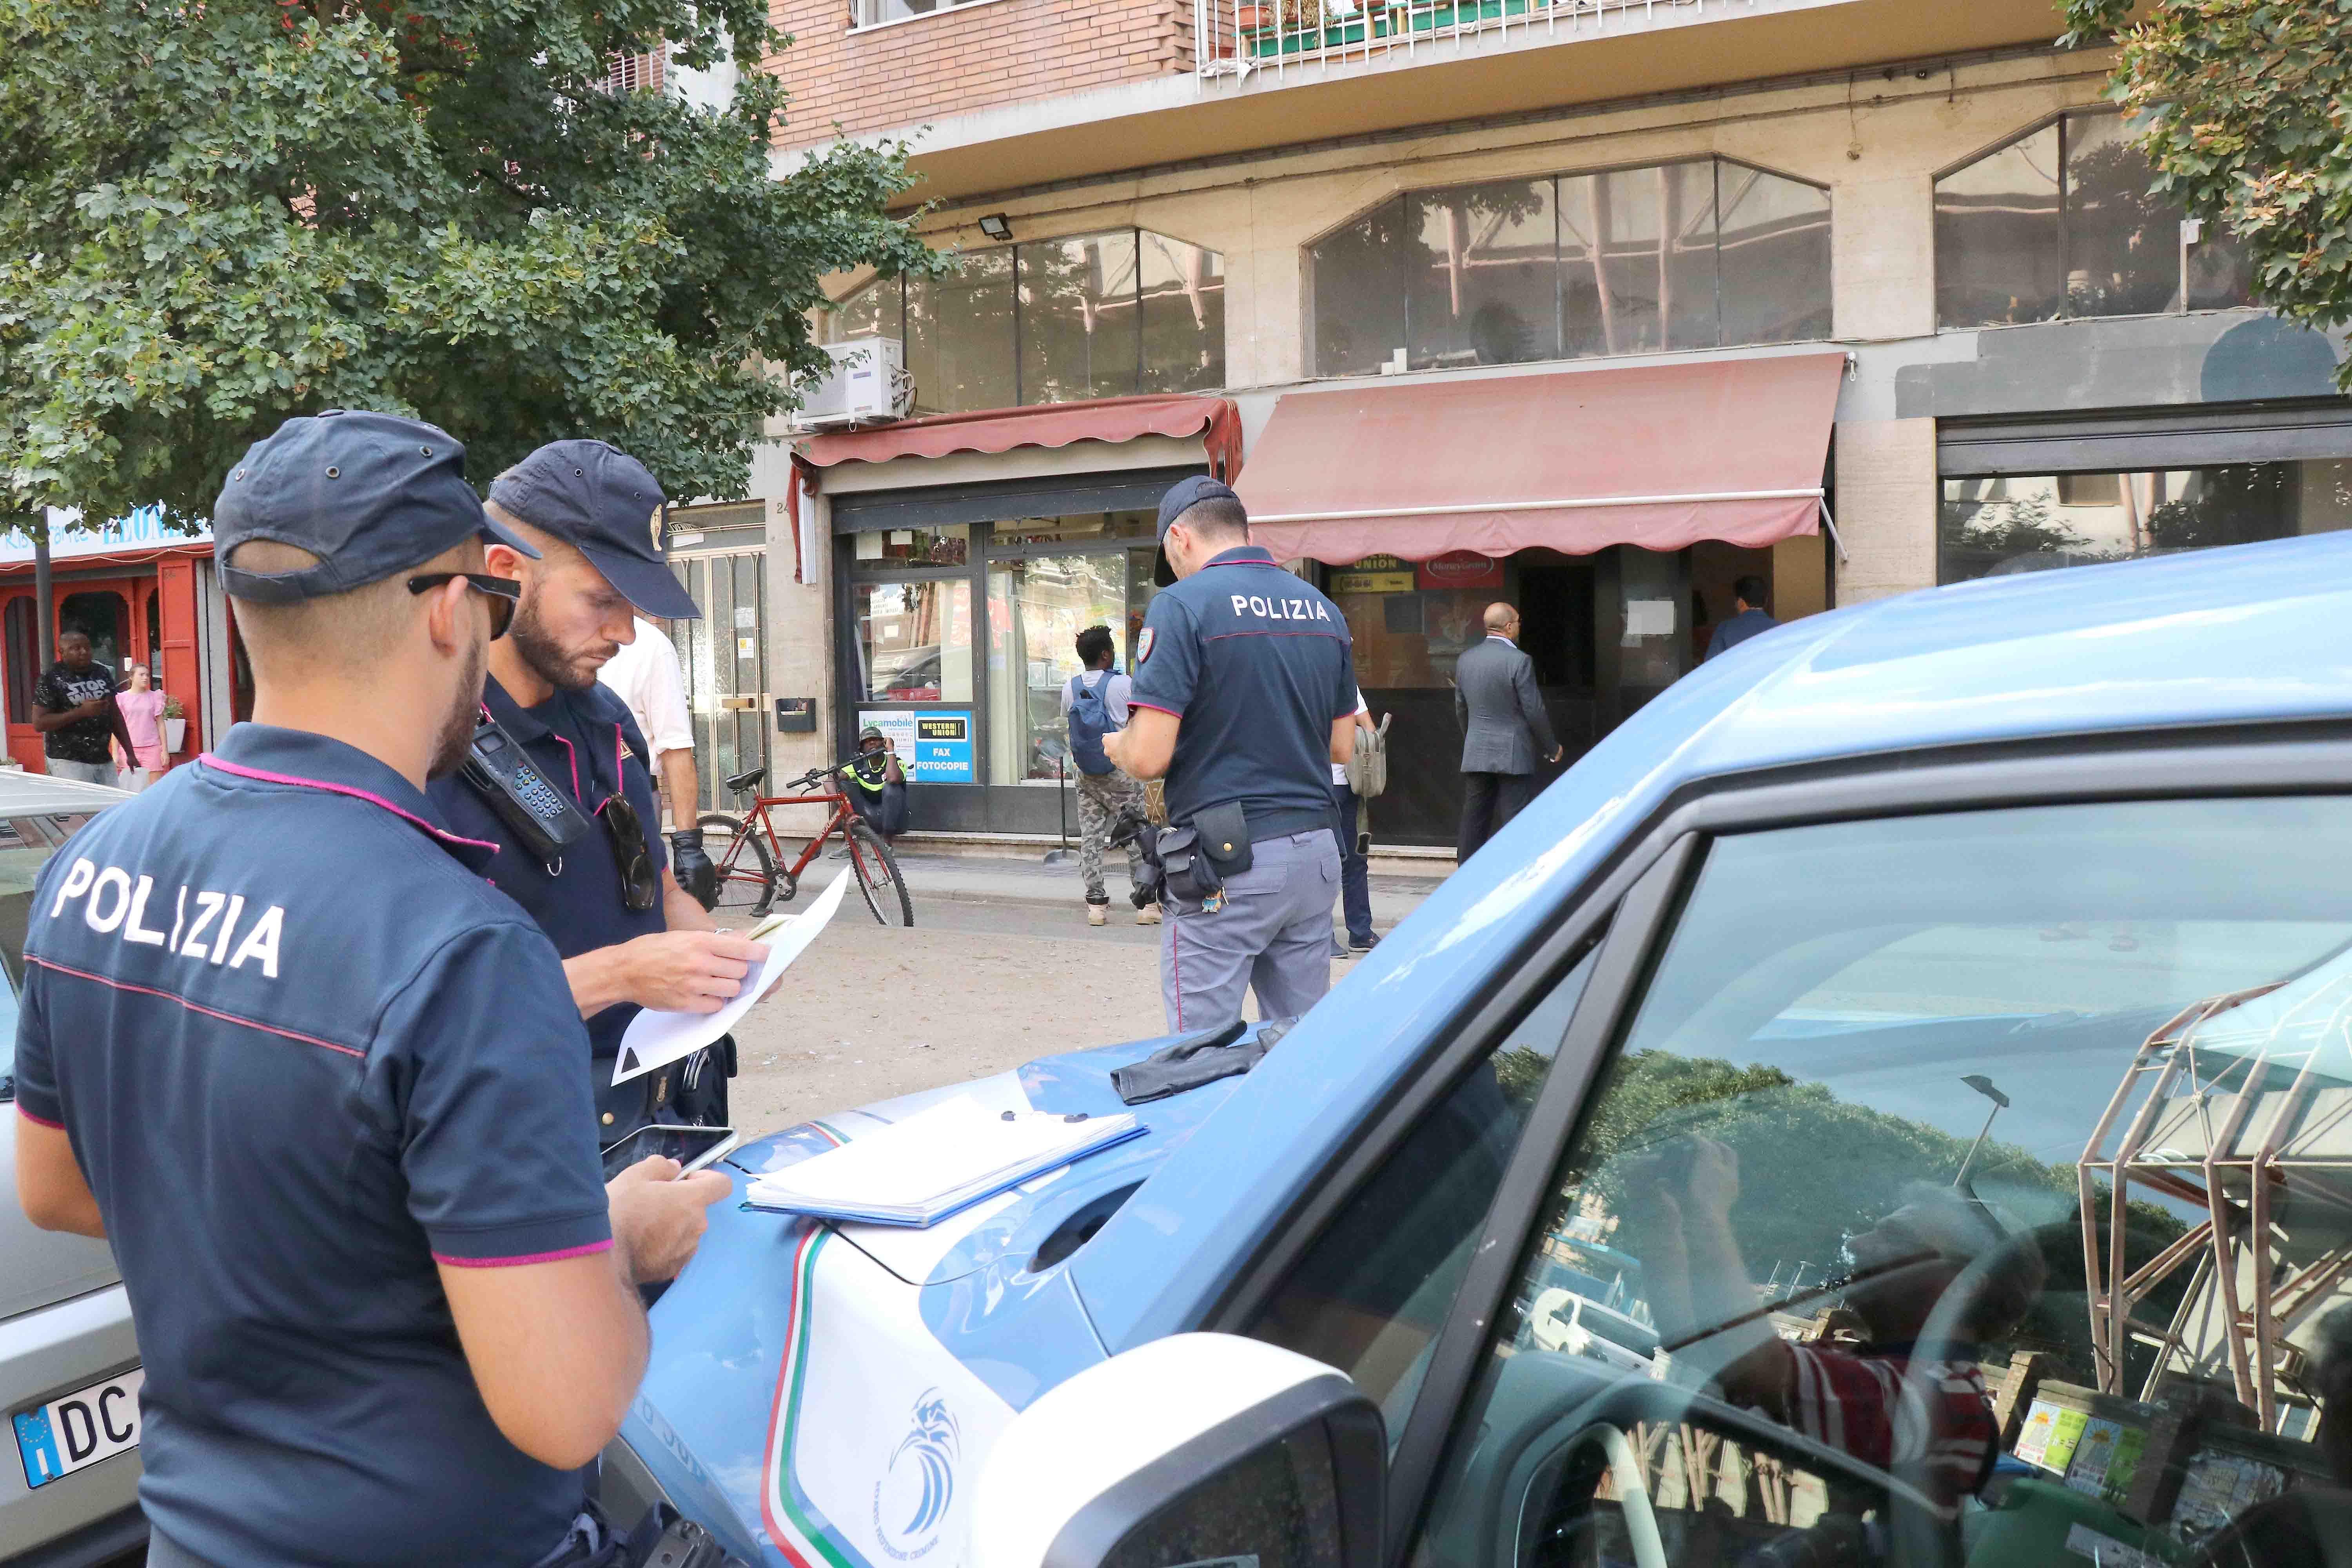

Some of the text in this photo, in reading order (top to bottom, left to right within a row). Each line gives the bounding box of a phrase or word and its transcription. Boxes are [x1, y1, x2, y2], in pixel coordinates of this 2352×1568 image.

[1354, 558, 1397, 568] UNION
[1230, 595, 1330, 622] POLIZIA
[67, 679, 107, 697] STOP
[863, 718, 913, 728] Lycamobile
[933, 748, 951, 757] FAX
[916, 762, 969, 771] FOTOCOPIE
[51, 857, 284, 978] POLIZIA
[58, 1386, 133, 1463] DC
